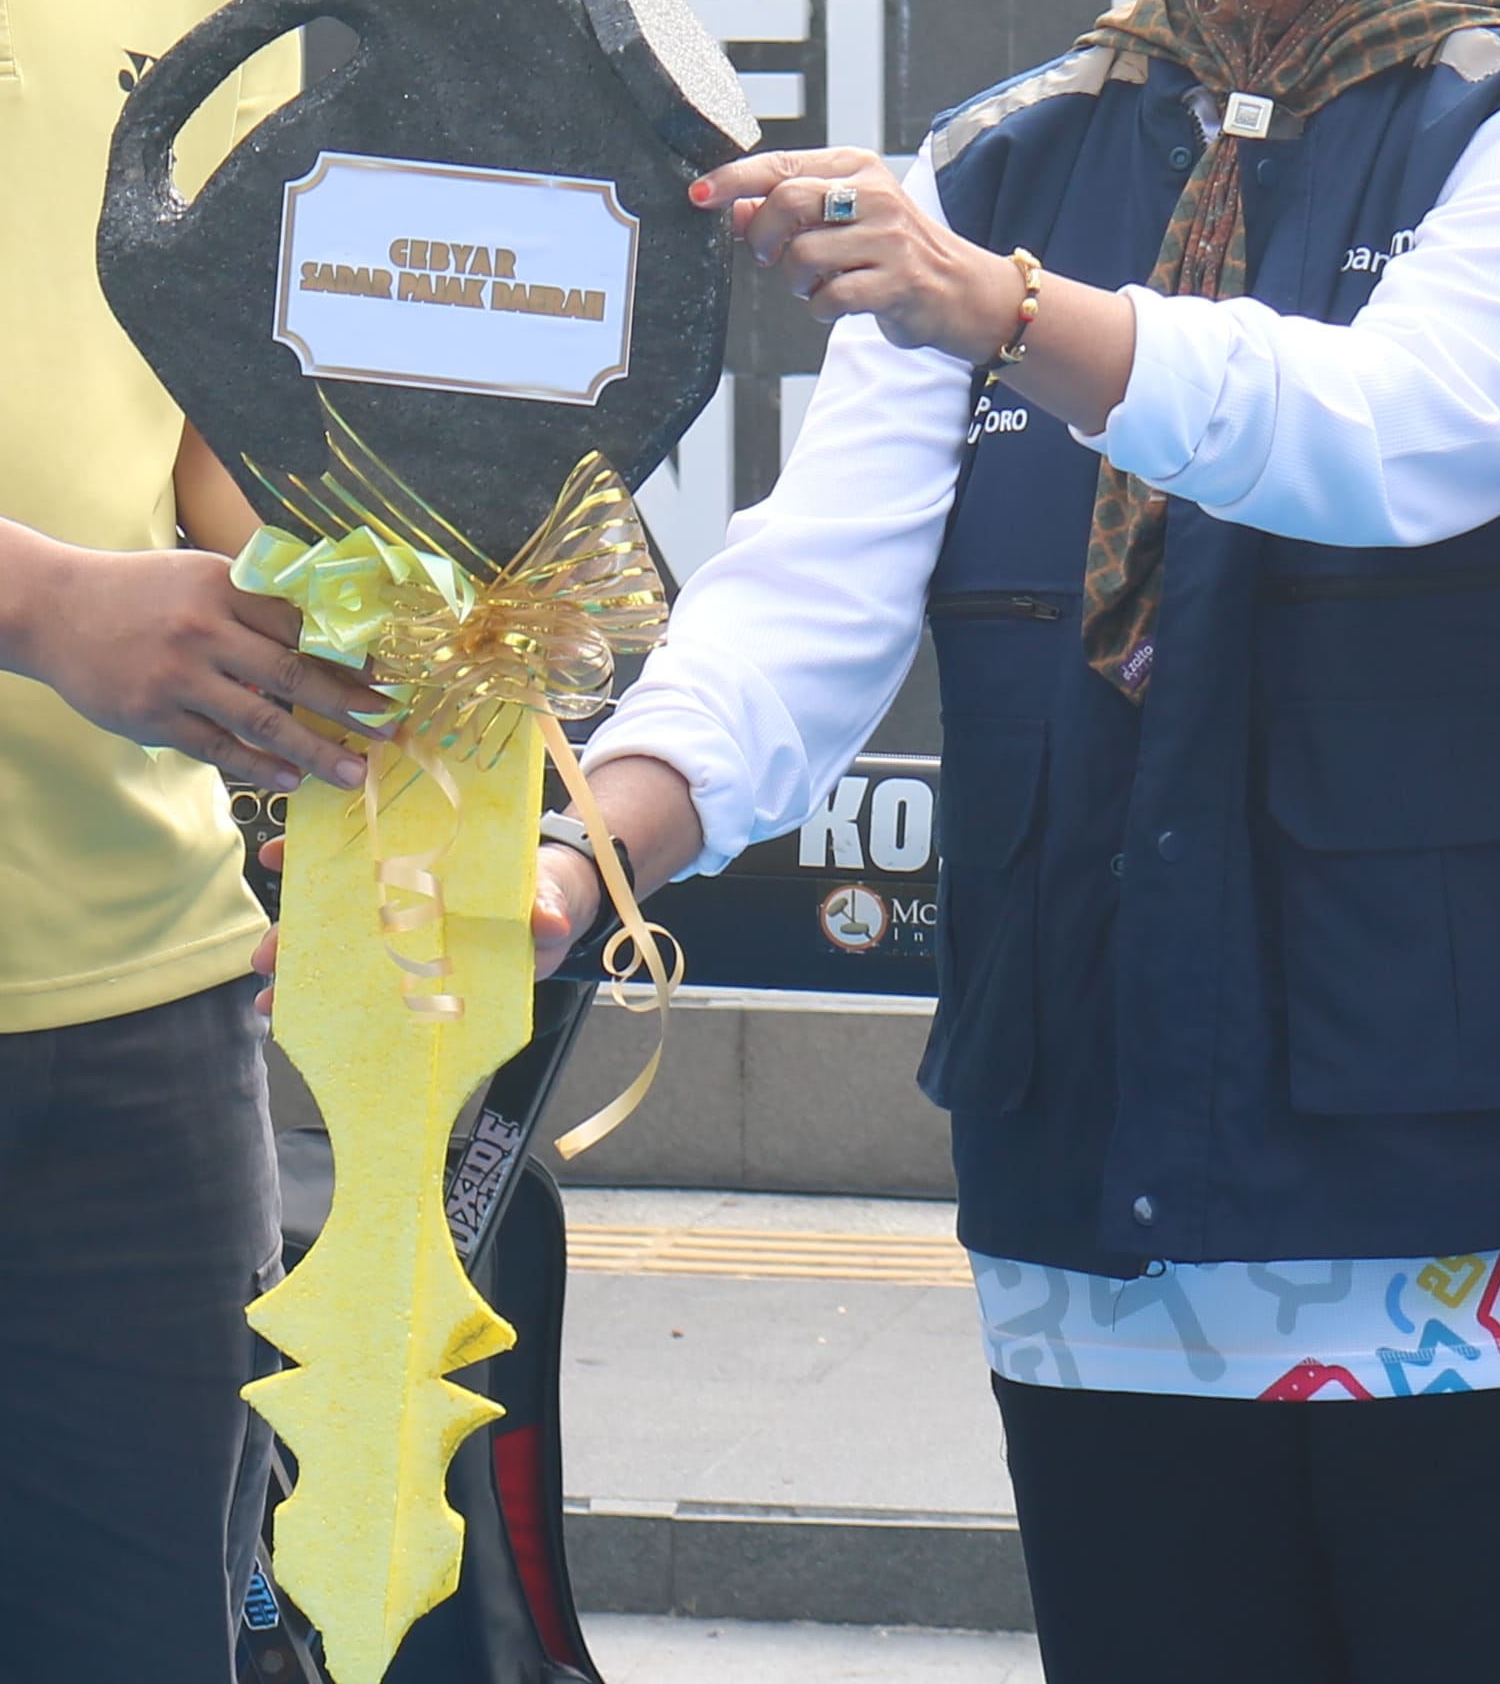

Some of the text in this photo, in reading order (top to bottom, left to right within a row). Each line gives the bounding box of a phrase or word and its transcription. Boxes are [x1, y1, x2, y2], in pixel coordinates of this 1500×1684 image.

[388, 238, 517, 279] GEBYAR
[299, 261, 606, 322] SADAR PAJAK DAERAH
[799, 776, 944, 873] KO
